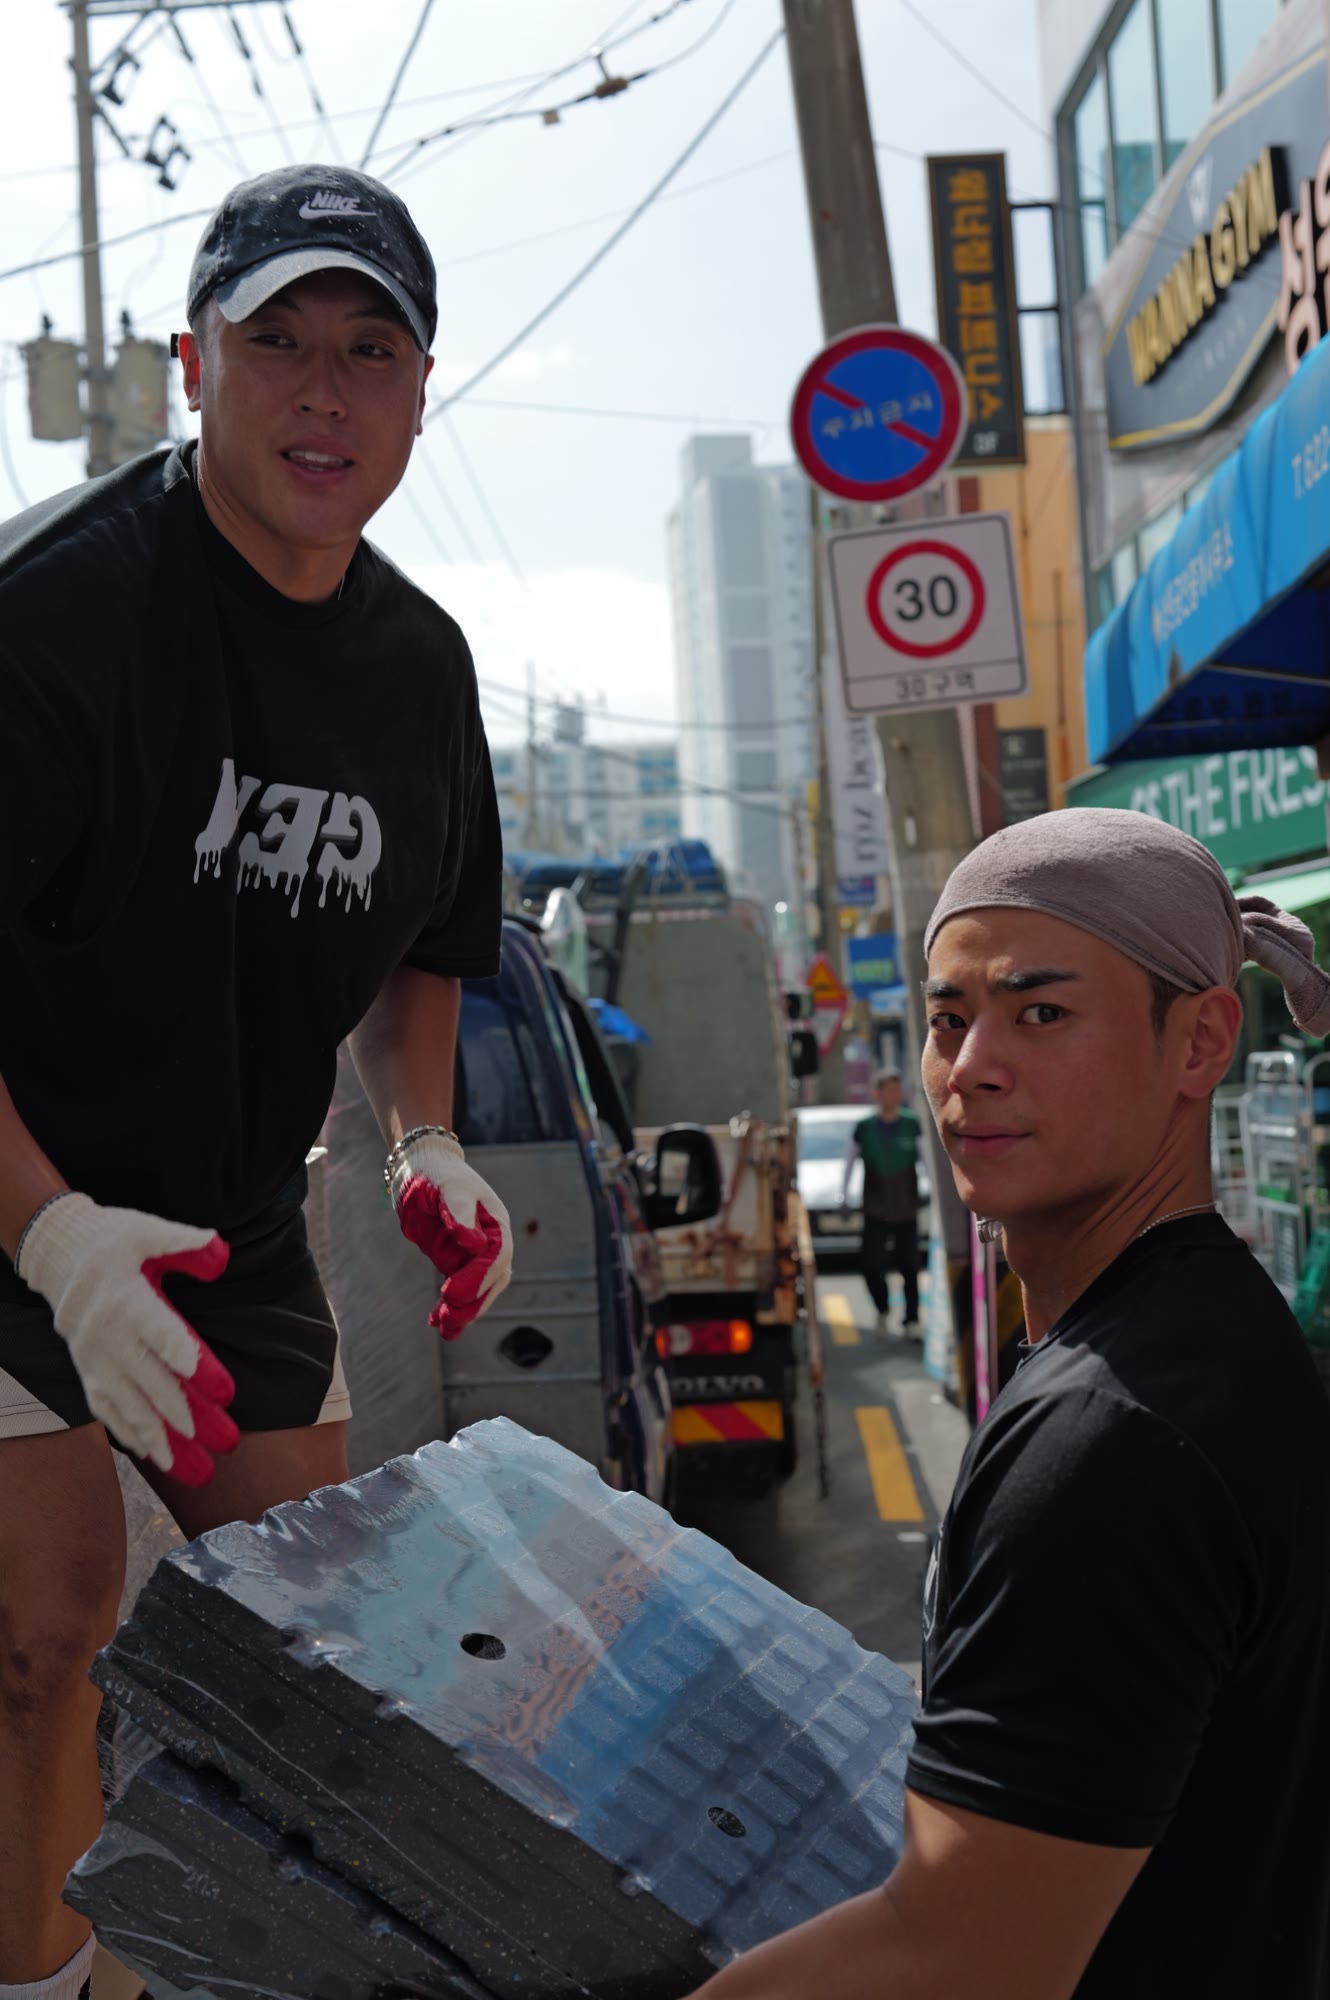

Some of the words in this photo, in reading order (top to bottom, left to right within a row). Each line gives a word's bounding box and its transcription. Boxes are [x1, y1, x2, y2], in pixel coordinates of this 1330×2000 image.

[310, 191, 361, 210] NIKE
[1210, 145, 1279, 290] GYM
[895, 574, 958, 622] 30
[1162, 755, 1227, 842] THE
[1229, 744, 1330, 830] FRES
